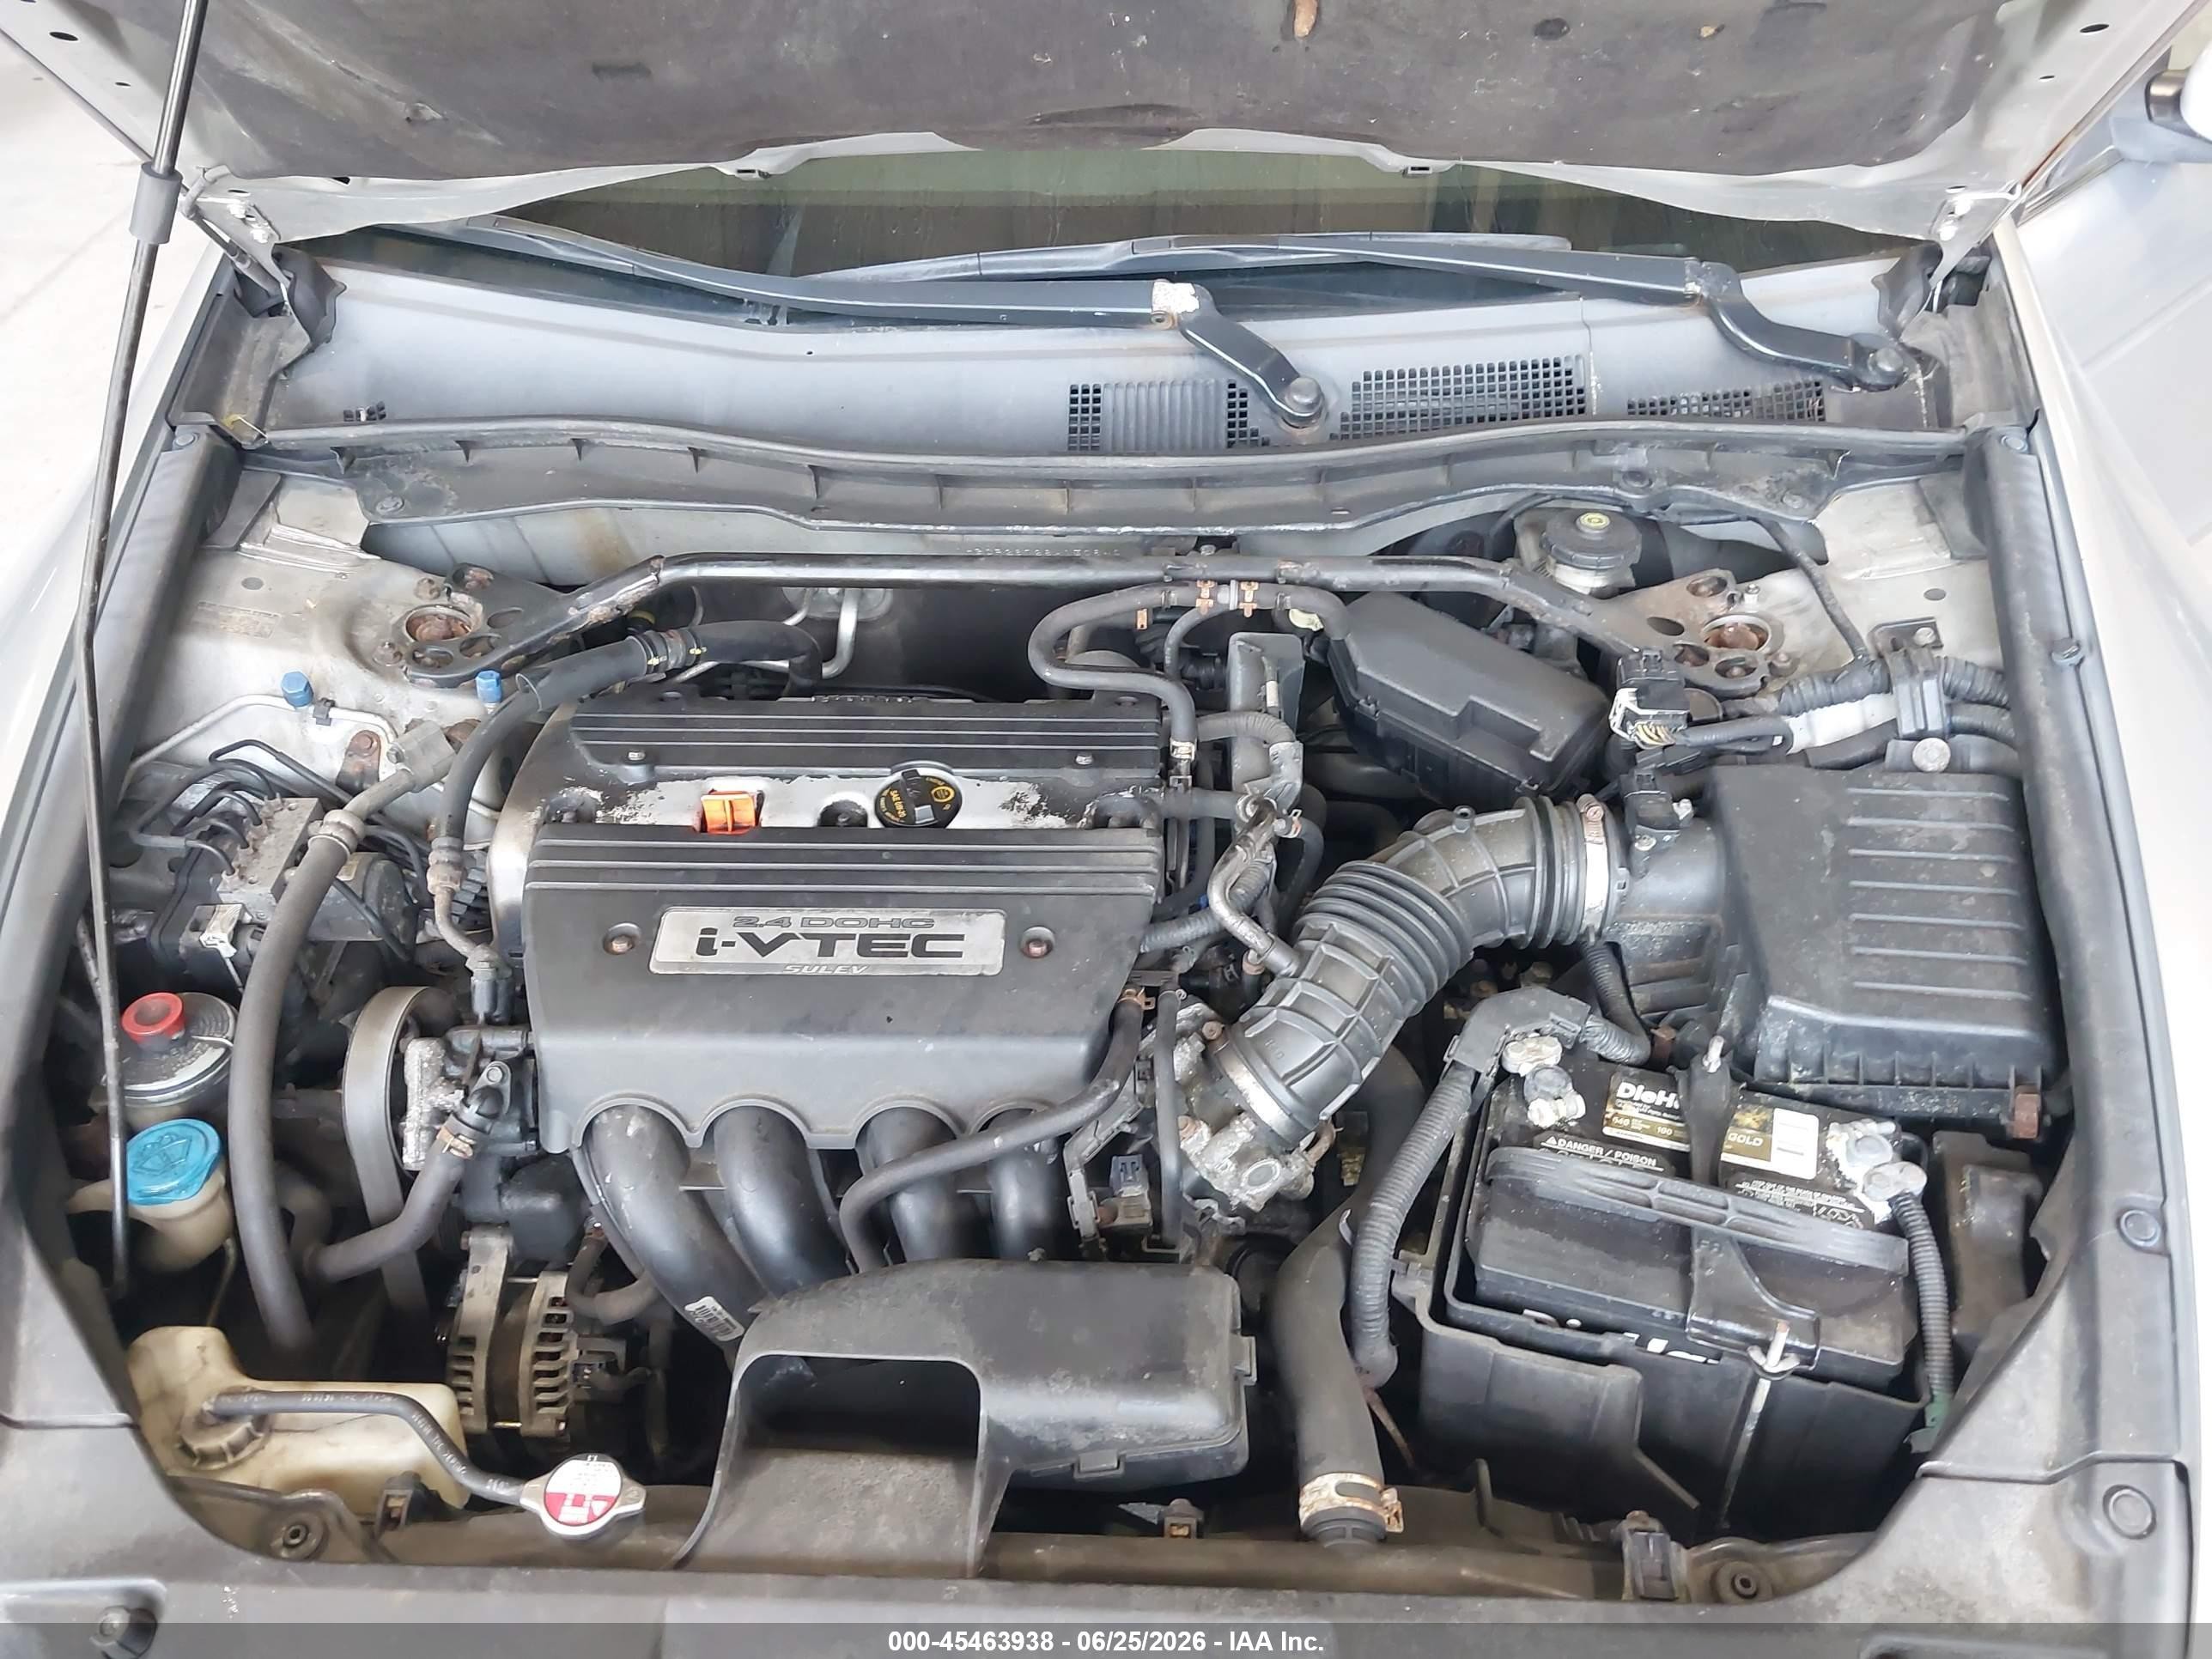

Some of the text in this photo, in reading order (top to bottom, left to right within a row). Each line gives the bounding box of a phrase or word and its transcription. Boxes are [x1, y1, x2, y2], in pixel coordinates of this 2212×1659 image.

[732, 915, 935, 929] 2.4 DOHC
[695, 927, 965, 958] i-VTEC
[783, 964, 869, 975] SULEV
[1728, 1132, 1765, 1147] GOLD
[1557, 1138, 1604, 1157] DANGER
[1614, 1150, 1656, 1167] POISON
